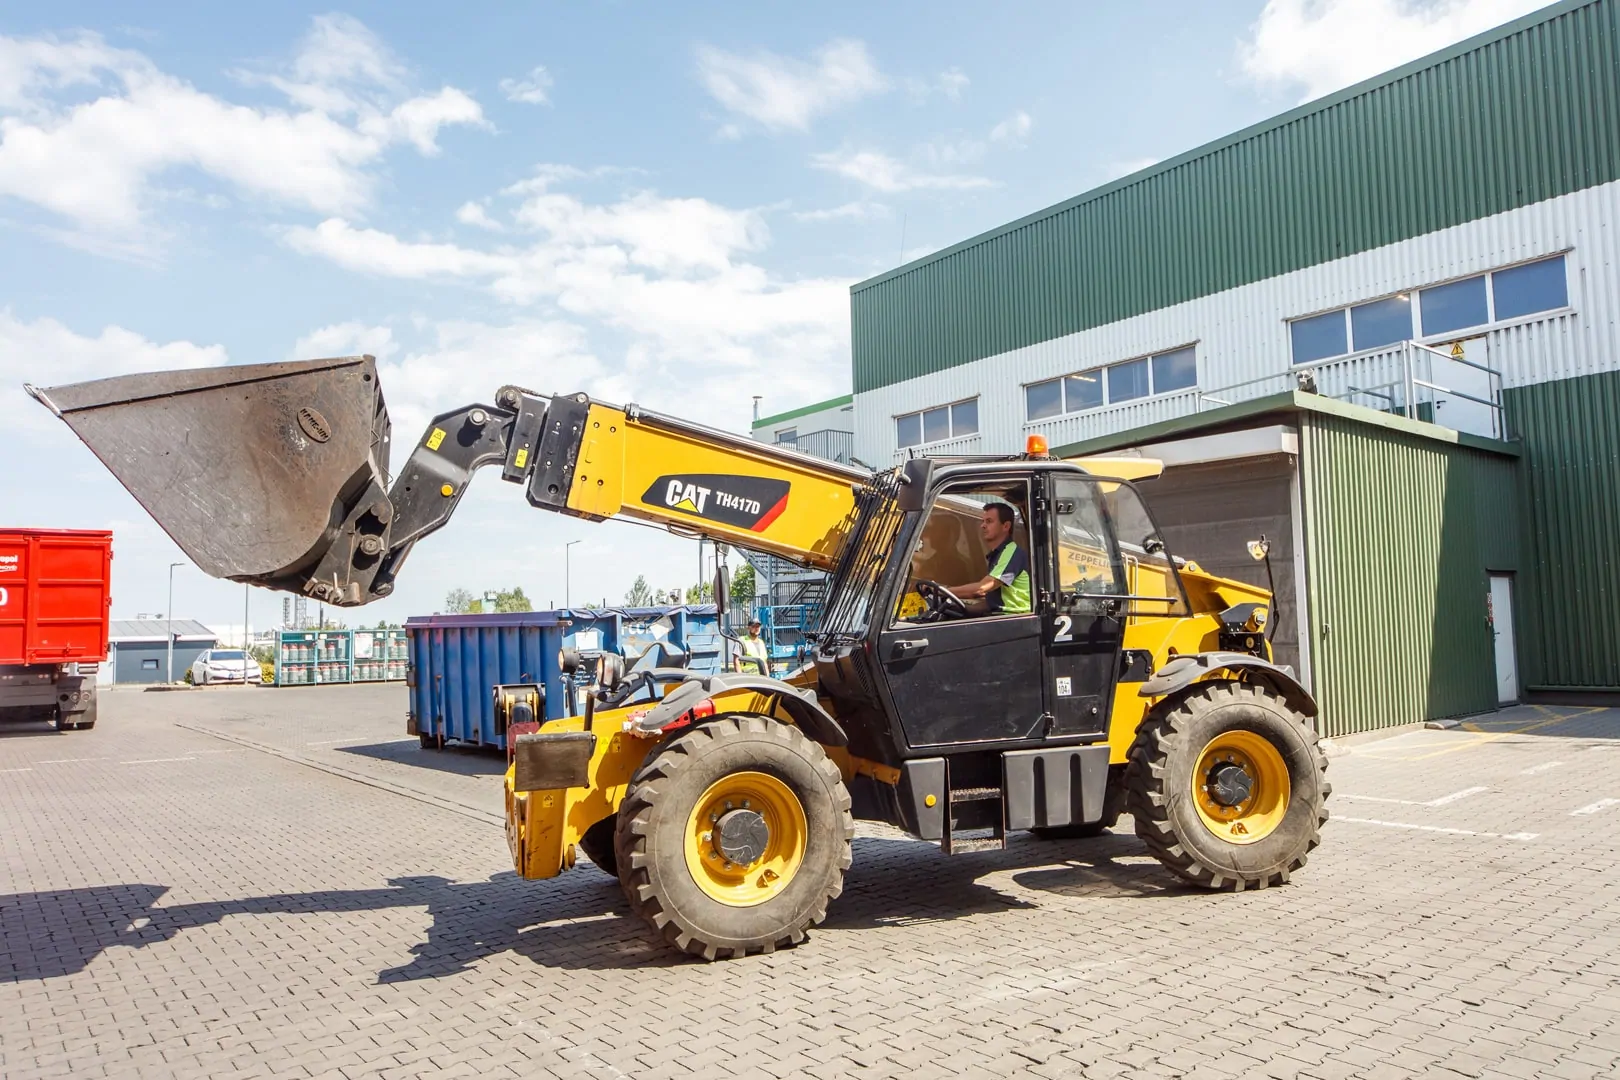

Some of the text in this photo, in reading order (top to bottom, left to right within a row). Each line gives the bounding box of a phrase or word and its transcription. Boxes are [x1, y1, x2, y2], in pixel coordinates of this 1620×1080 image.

[665, 479, 761, 515] CAT TH417D
[1067, 551, 1110, 569] ZEPPELI
[1054, 615, 1073, 642] 2
